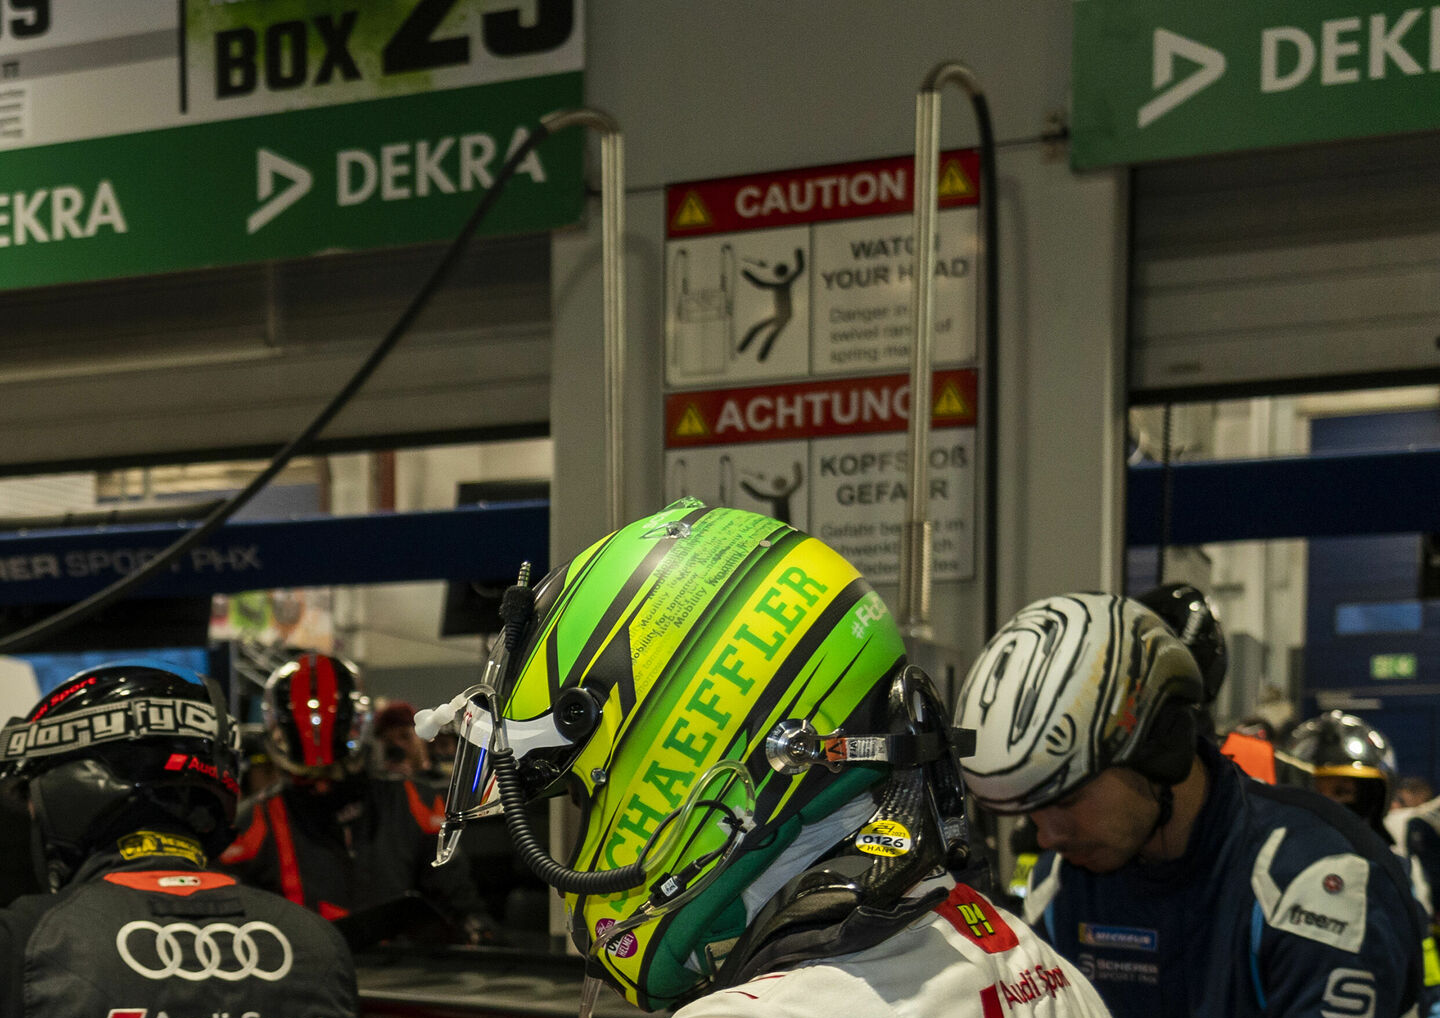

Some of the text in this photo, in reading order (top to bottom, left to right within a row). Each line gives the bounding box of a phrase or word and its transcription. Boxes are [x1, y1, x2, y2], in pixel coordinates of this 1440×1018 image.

[214, 10, 361, 99] BOX
[1260, 4, 1440, 94] DEK
[336, 126, 547, 207] DEKRA
[734, 169, 907, 219] CAUTION
[821, 257, 969, 291] YOUR HAD
[836, 479, 948, 506] GEFAR
[190, 544, 264, 575] PHX
[674, 587, 707, 628] Mobility
[6, 698, 176, 757] gloryfy
[863, 835, 904, 849] 0126
[867, 844, 896, 855] HANS
[619, 933, 636, 958] HELMET
[1000, 967, 1043, 1010] Audi
